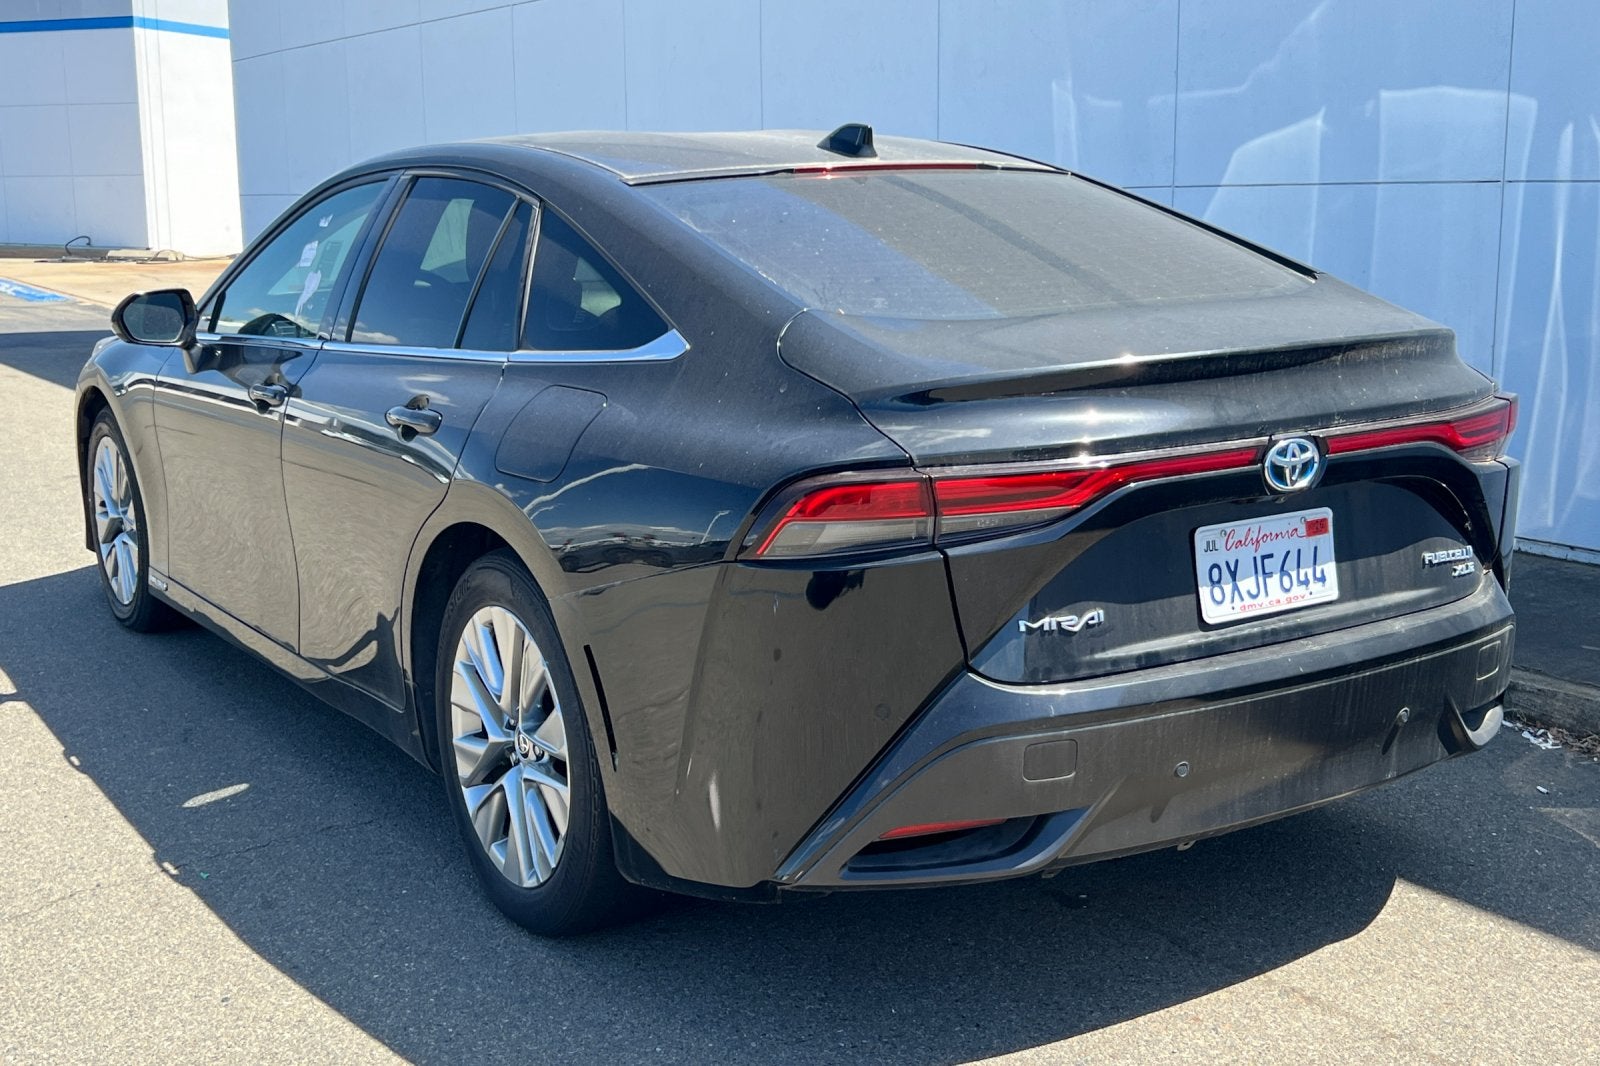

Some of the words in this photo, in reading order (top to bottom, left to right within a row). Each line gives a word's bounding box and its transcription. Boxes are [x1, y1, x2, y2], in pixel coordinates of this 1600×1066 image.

[1204, 540, 1218, 552] JUL
[1225, 526, 1306, 553] California
[1208, 545, 1327, 606] 8XJF644
[1239, 593, 1306, 612] dmv.ca.gov
[1018, 609, 1104, 632] MIRAI
